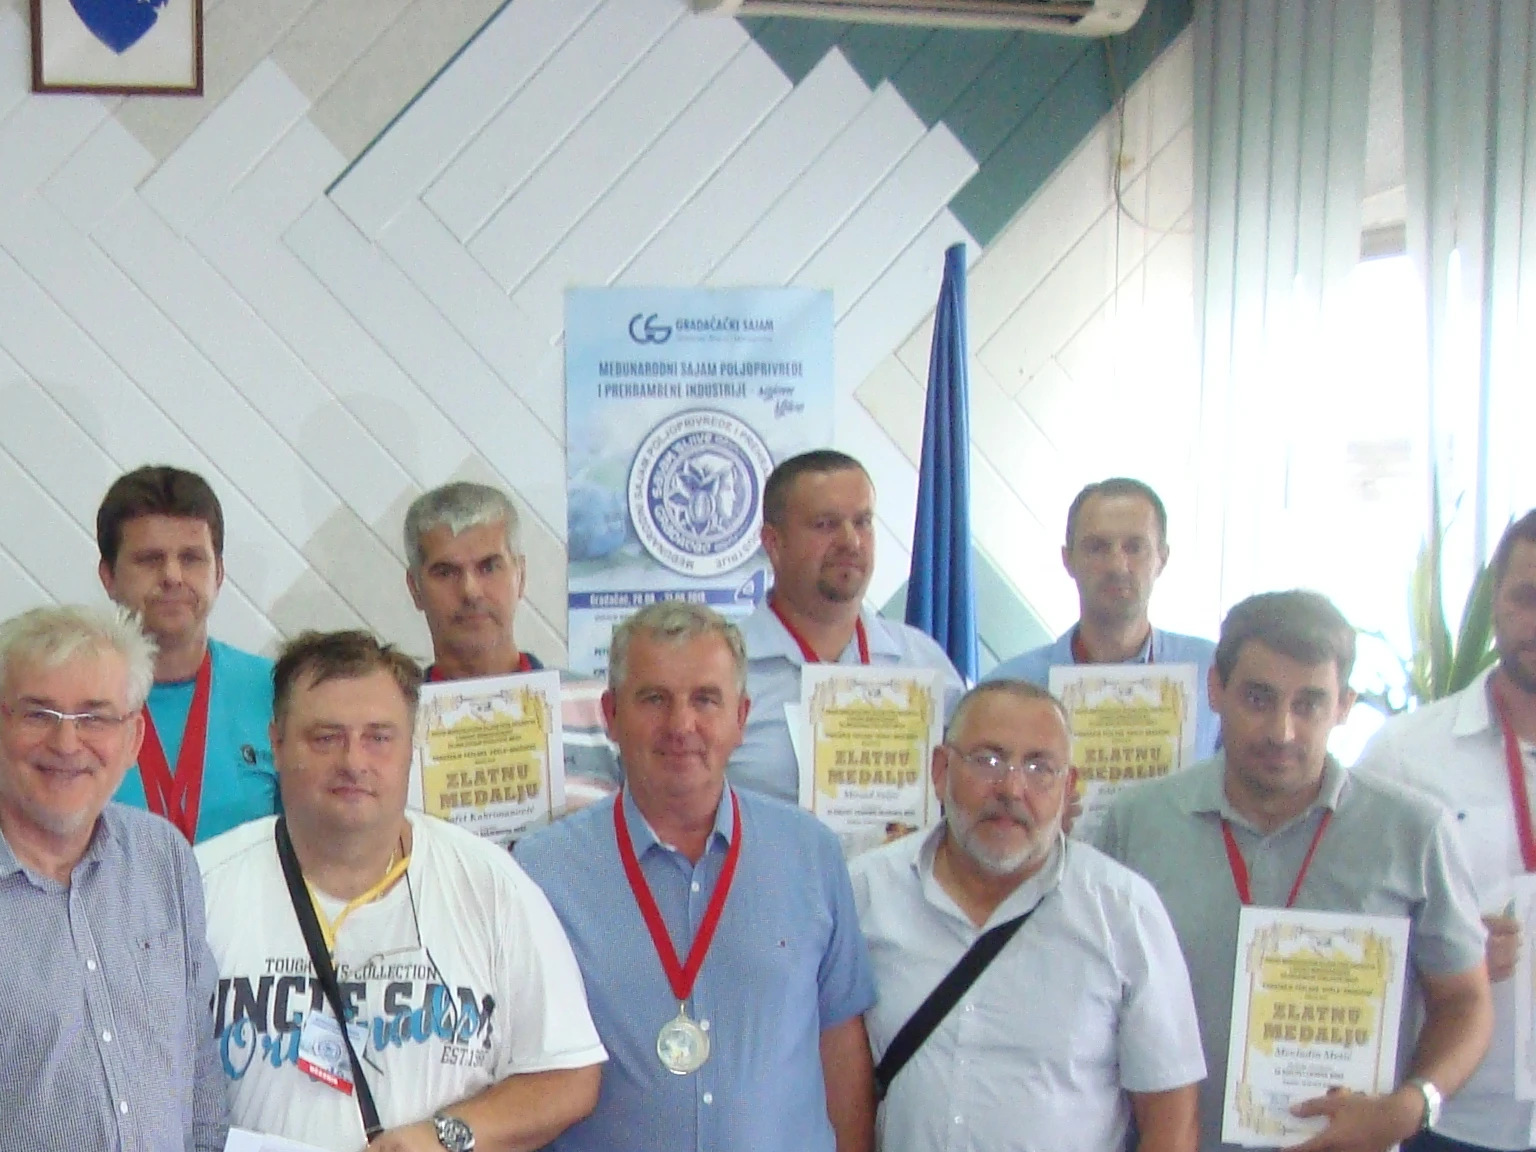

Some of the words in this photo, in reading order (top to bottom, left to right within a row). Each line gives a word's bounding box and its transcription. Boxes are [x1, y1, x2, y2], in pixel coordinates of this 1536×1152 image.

[743, 318, 774, 331] SAJAM
[680, 361, 717, 376] SAJAM
[720, 361, 804, 377] POLJOPRIVREDE
[604, 383, 682, 399] PREHRAMBENE
[686, 382, 747, 398] INDUSTRIJE
[446, 764, 529, 789] ZLATNU
[440, 783, 539, 810] MEDALJU
[1273, 1002, 1360, 1025] ZLATNU
[1263, 1022, 1368, 1049] MEDALJU
